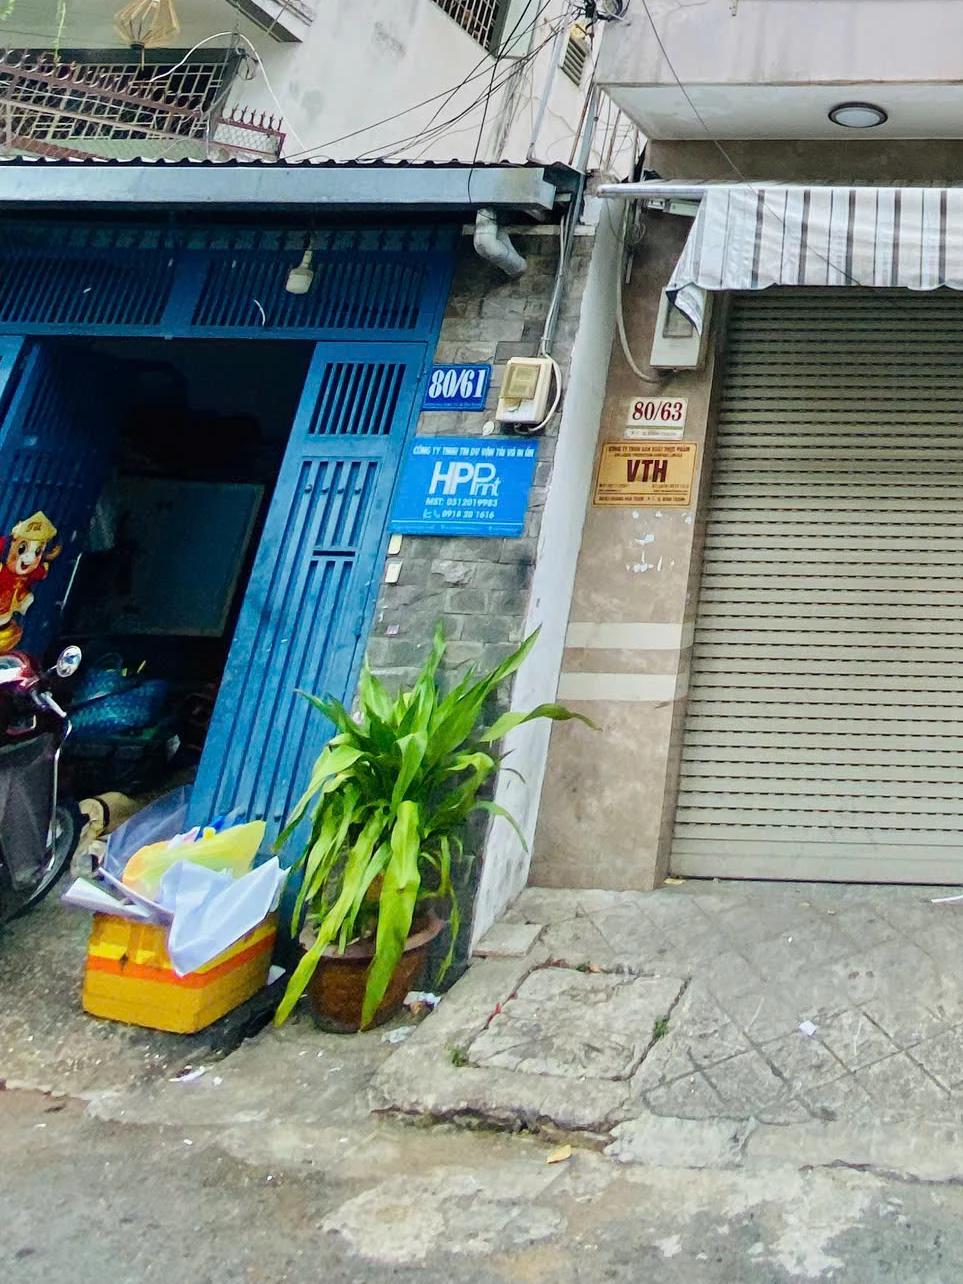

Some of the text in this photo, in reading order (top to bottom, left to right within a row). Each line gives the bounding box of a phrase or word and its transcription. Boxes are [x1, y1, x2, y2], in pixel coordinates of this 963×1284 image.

[428, 369, 486, 398] 80/61
[632, 400, 683, 422] 80/63
[626, 459, 668, 482] VTH
